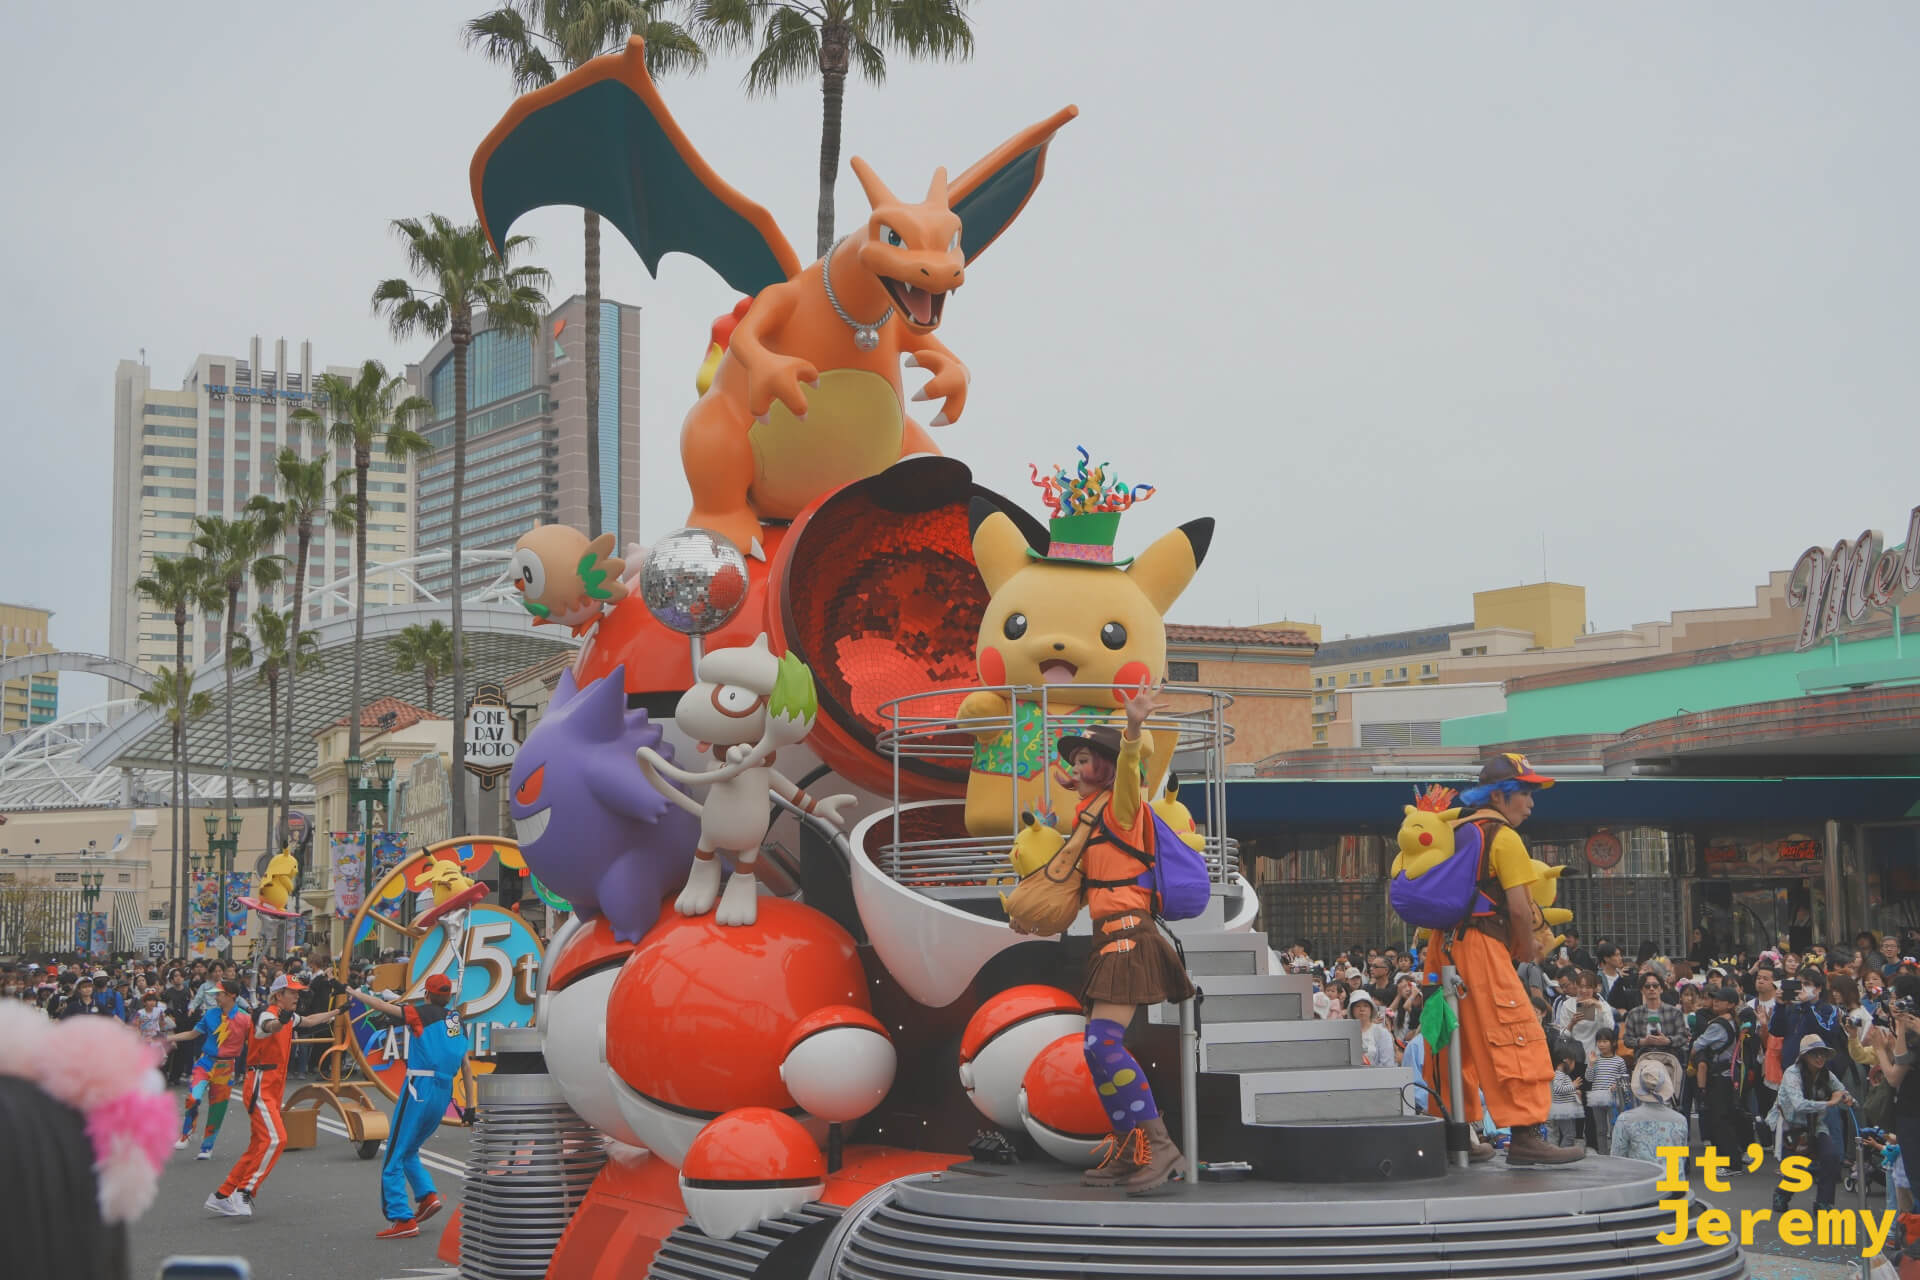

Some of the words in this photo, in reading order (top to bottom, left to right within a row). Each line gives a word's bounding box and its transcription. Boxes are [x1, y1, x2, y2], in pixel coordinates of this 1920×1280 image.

[473, 710, 505, 725] ONE
[474, 726, 504, 741] DAY
[463, 742, 515, 757] PHOTO
[150, 943, 165, 952] 30
[399, 922, 541, 1015] 25t
